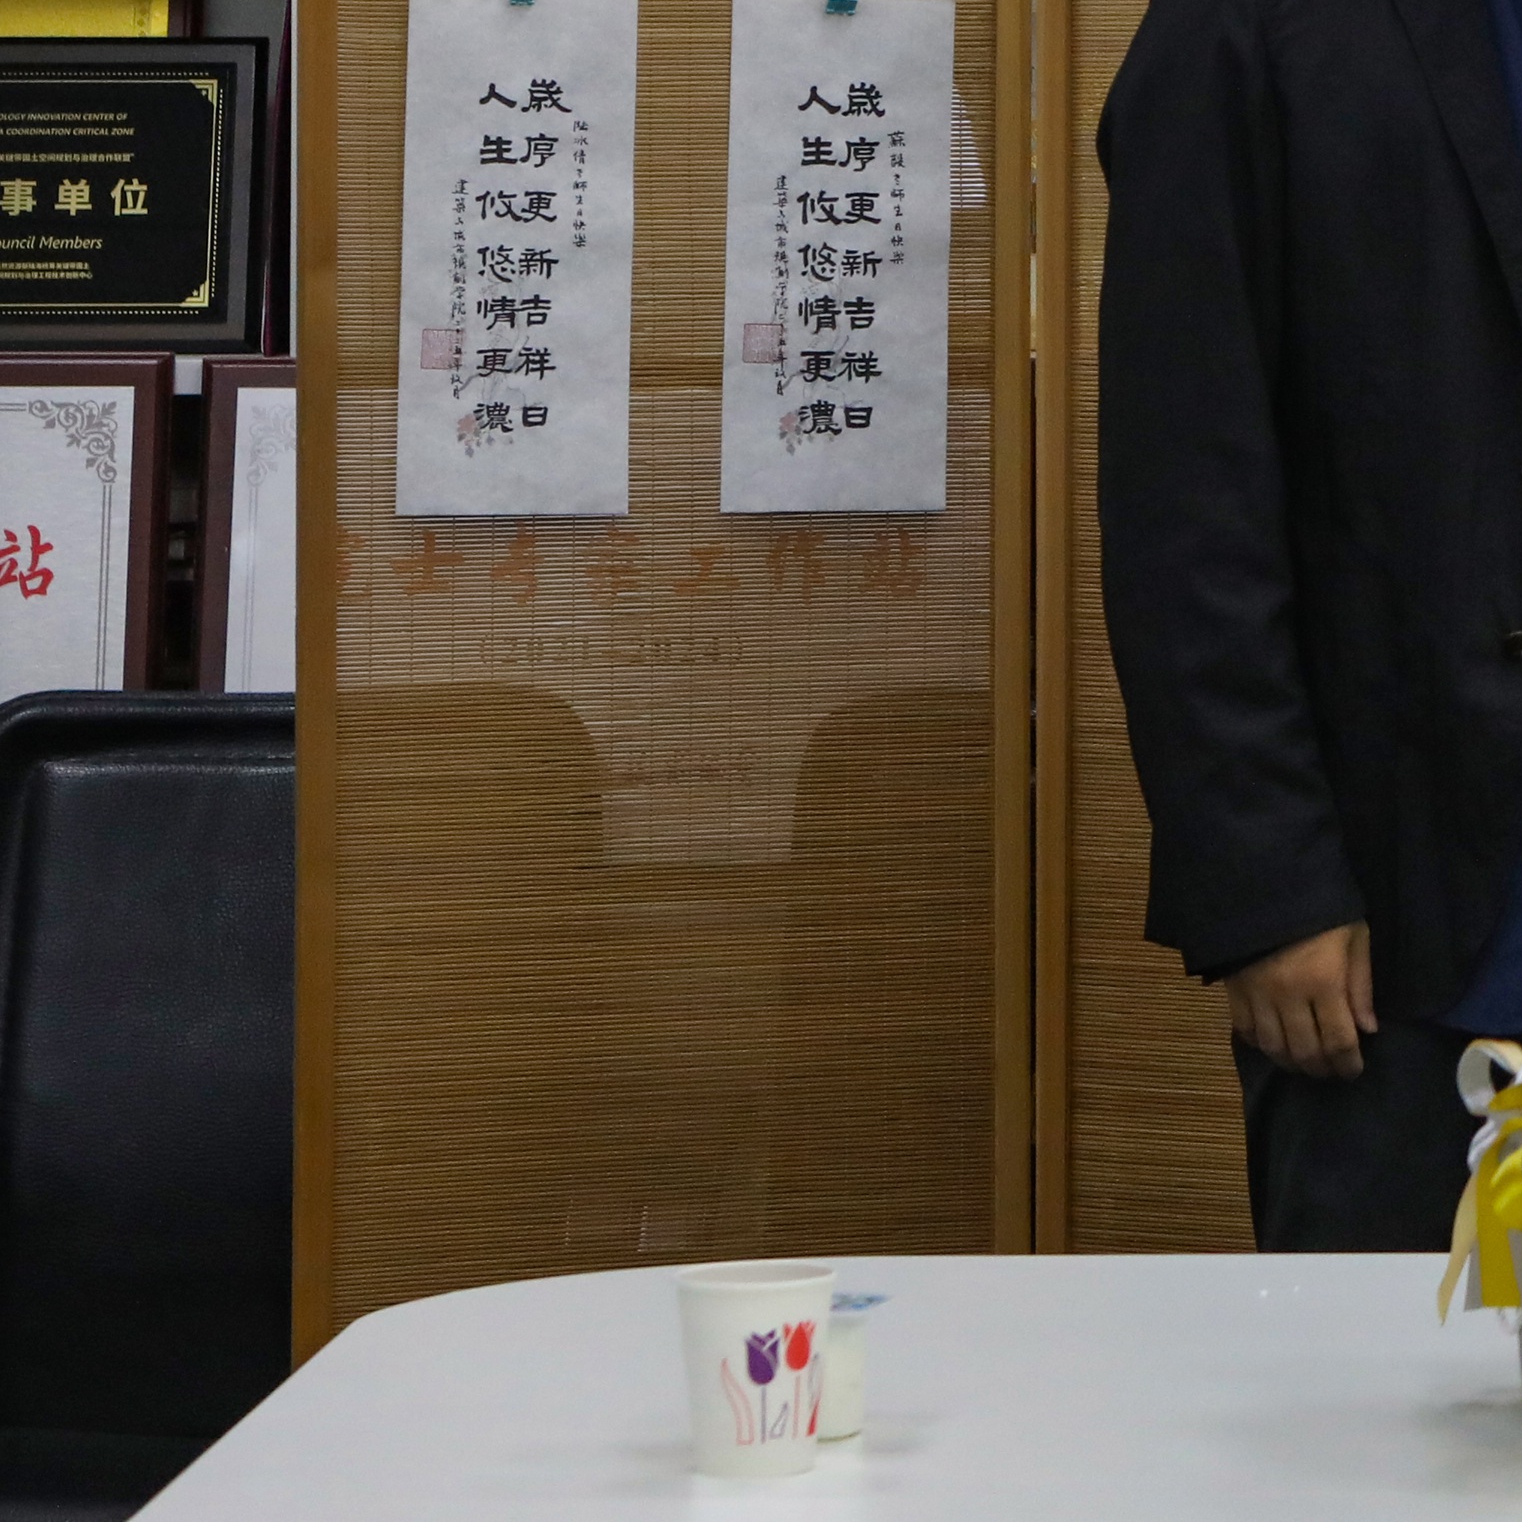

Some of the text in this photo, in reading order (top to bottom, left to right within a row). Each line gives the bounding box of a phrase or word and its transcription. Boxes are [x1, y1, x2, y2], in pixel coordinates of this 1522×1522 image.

[27, 112, 82, 121] INNOVATION
[83, 112, 115, 121] CENTER
[116, 112, 128, 121] OF
[6, 127, 135, 136] COORDINATION CRITICAL ZONE
[40, 234, 103, 250] Members
[0, 524, 54, 600] 站
